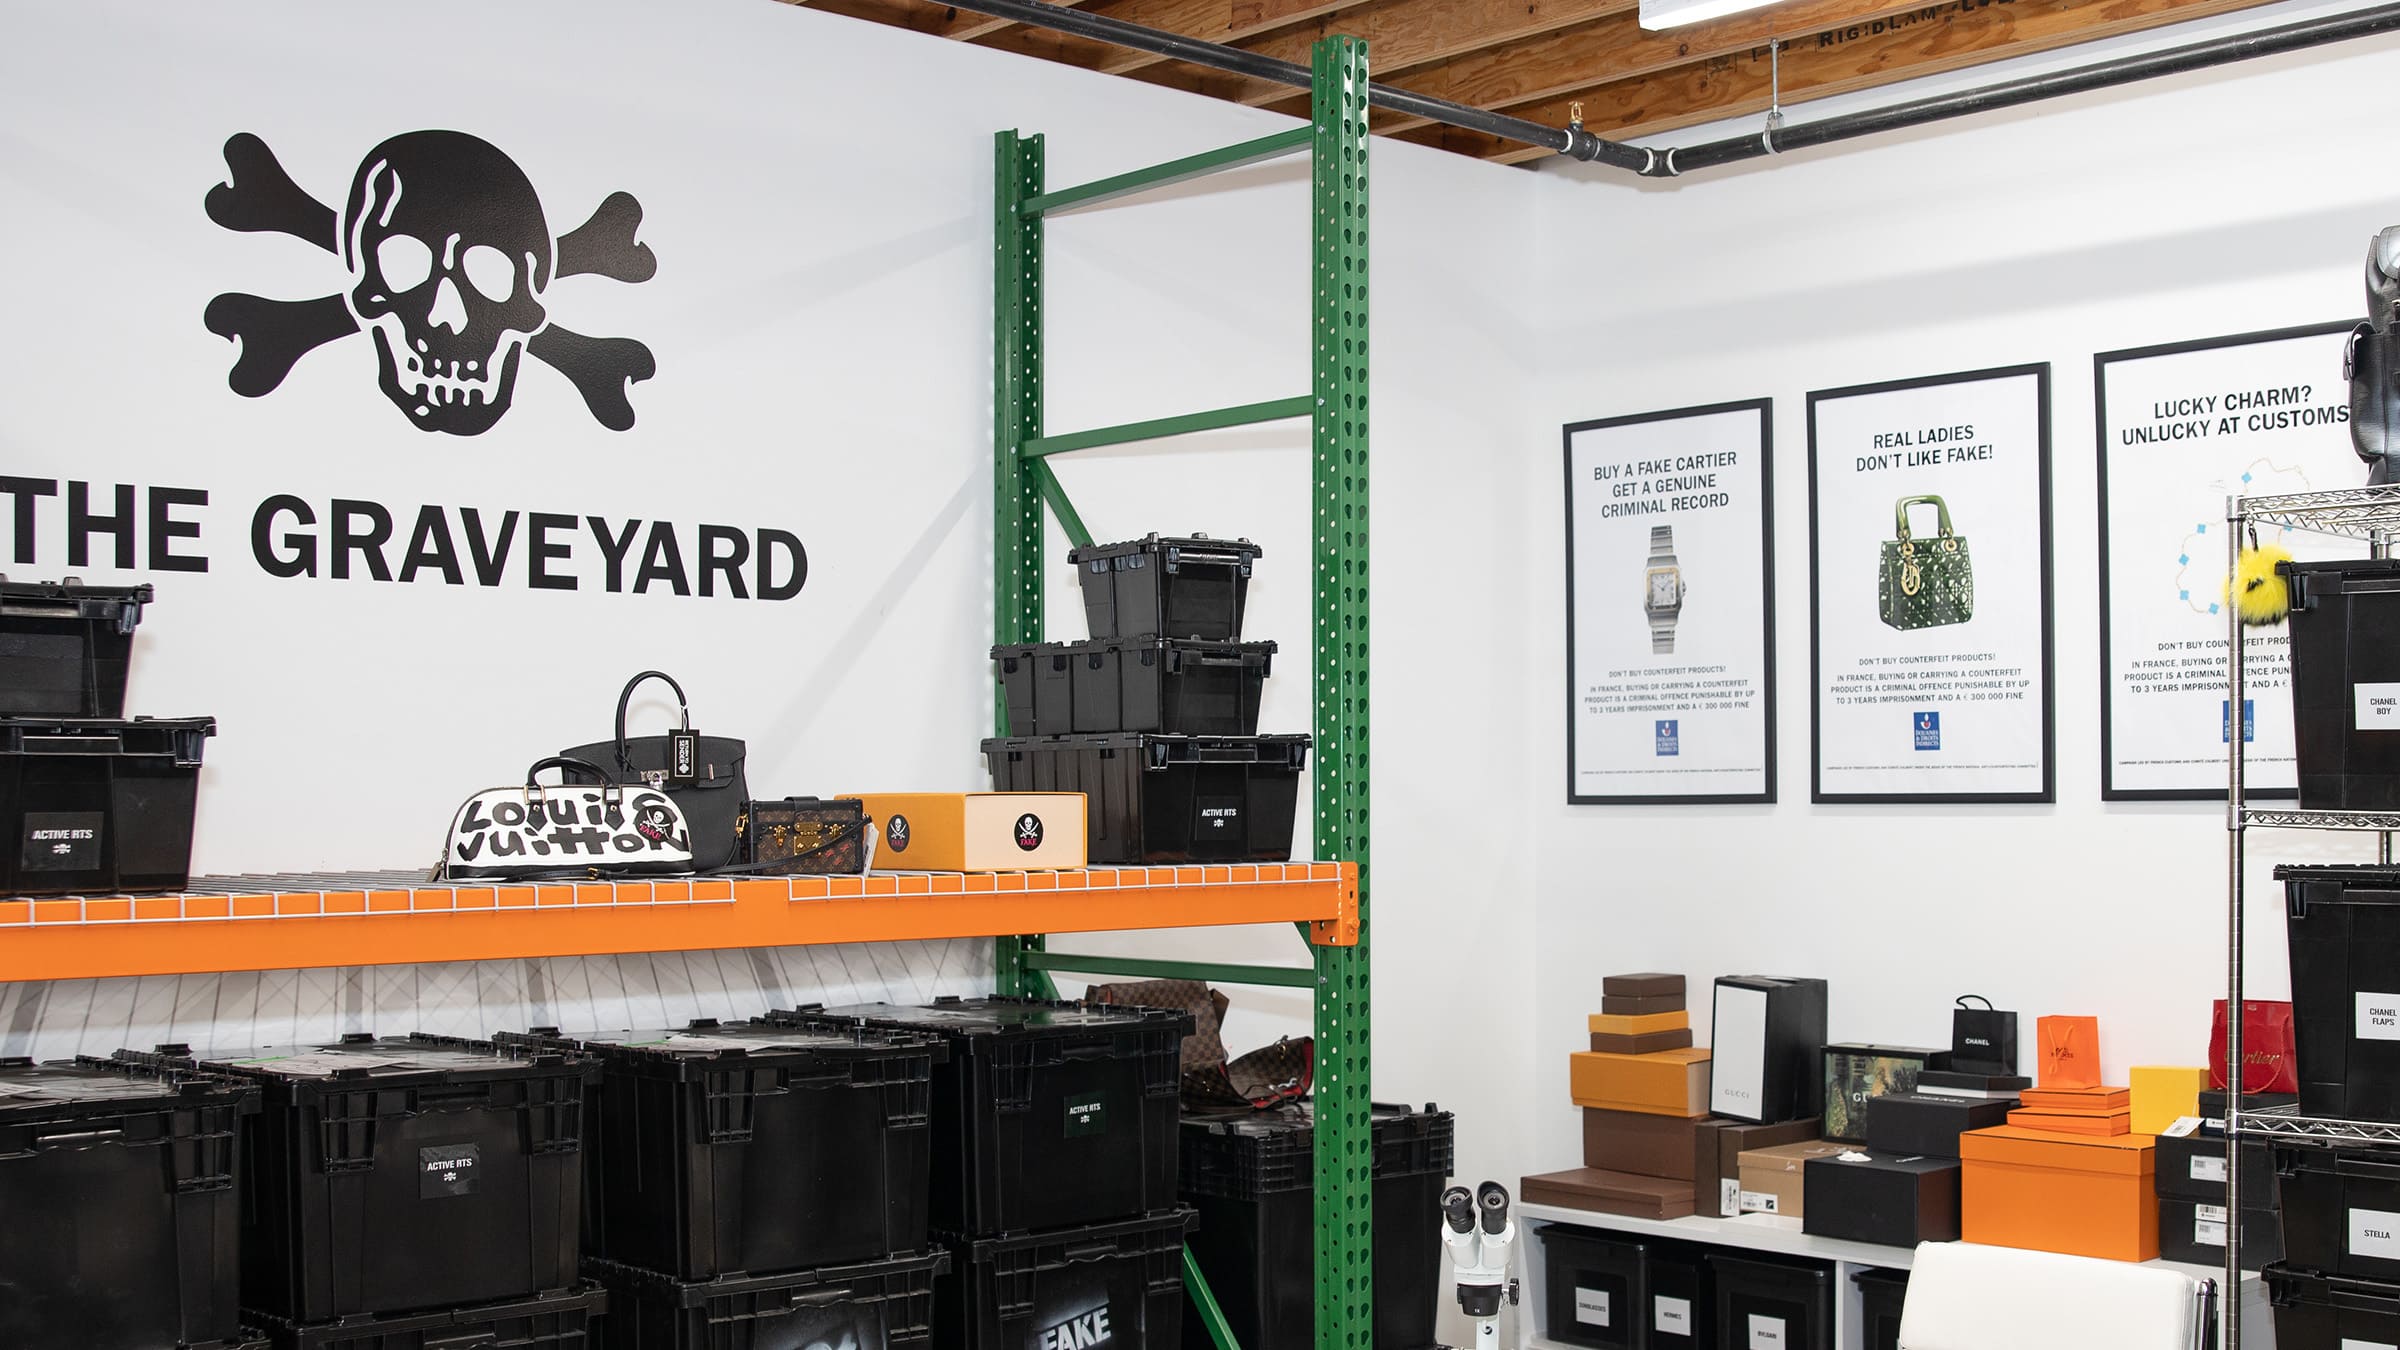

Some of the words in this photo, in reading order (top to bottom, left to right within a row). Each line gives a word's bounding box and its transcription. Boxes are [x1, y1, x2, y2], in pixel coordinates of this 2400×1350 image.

[2154, 396, 2216, 419] LUCKY
[2224, 385, 2312, 411] CHARM?
[2122, 420, 2210, 445] UNLUCKY
[2218, 417, 2241, 435] AT
[2248, 405, 2349, 431] CUSTOMS
[1874, 432, 1912, 449] REAL
[1919, 425, 1973, 444] LADIES
[1857, 454, 1902, 472] DON'T
[1908, 450, 1941, 466] LIKE
[1948, 445, 1992, 462] FAKE!
[1594, 465, 1620, 480] BUY
[1625, 464, 1633, 477] A
[1638, 459, 1671, 475] FAKE
[1676, 452, 1736, 471] CARTIER
[1613, 483, 1637, 497] GET
[1642, 481, 1650, 494] A
[1656, 474, 1716, 493] GENUINE
[1602, 499, 1666, 518] CRIMINAL
[1672, 493, 1728, 511] RECORD
[0, 475, 208, 573] THE
[250, 494, 808, 601] GRAVEYARD
[2158, 642, 2183, 650] DON'T
[2186, 641, 2203, 649] BUY
[2205, 638, 2264, 648] COUNFEIT
[1859, 657, 1880, 666] DON'T
[1883, 657, 1897, 665] BUY
[1899, 655, 1949, 664] COUNTERFEIT
[1952, 653, 1996, 662] PRODUCTS!
[2143, 660, 2178, 668] FRANCE,
[2182, 658, 2213, 667] BUYING
[2216, 657, 2227, 665] OR
[1643, 667, 1686, 676] COUNTERFEIT
[1689, 666, 1726, 674] PRODUCTS!
[1879, 672, 1905, 681] BUYING
[1920, 670, 1958, 679] CARRYING
[1969, 668, 2021, 678] COUNTERFEIT
[2124, 672, 2162, 681] PRODUCT
[2166, 672, 2173, 680] IS
[2185, 670, 2226, 679] CRIMINAL
[1661, 682, 1694, 690] CARRYING
[1703, 680, 1748, 688] COUNTERFEIT
[1831, 685, 1862, 693] PRODUCT
[1882, 683, 1916, 692] CRIMINAL
[1919, 682, 1952, 691] OFFENCE
[1955, 680, 2003, 690] PUNISHABLE
[2006, 680, 2016, 688] BY
[2144, 685, 2149, 693] 3
[2152, 684, 2179, 693] YEARS
[1661, 693, 1688, 701] OFFENCE
[1691, 691, 1732, 700] PUNISHABLE
[1837, 697, 1845, 705] TO
[1854, 696, 1877, 704] YEARS
[1880, 694, 1935, 703] IMPRISONMENT
[1938, 693, 1954, 701] AND
[1956, 693, 1961, 701] A
[1971, 692, 1985, 701] 300
[1988, 692, 2003, 700] 000
[2006, 692, 2024, 700] FINE
[1627, 704, 1674, 712] IMPRISONMENT
[1735, 701, 1749, 709] FINE
[2370, 698, 2397, 706] CHANEL
[2376, 707, 2391, 715] BOY
[1202, 808, 1222, 818] ACTIVE
[1223, 808, 1237, 817] RTS
[32, 829, 70, 840] ACTIVE
[71, 829, 93, 840] RTS
[2369, 1008, 2397, 1016] CHANEL
[2372, 1018, 2394, 1026] FLAPS
[1965, 1037, 1990, 1046] CHANEL
[1069, 1104, 1088, 1115] ACTIVE
[427, 1160, 454, 1171] ACTIVE
[456, 1158, 472, 1168] RTS
[2364, 1229, 2390, 1239] STELLA
[1040, 1307, 1112, 1350] FAKE
